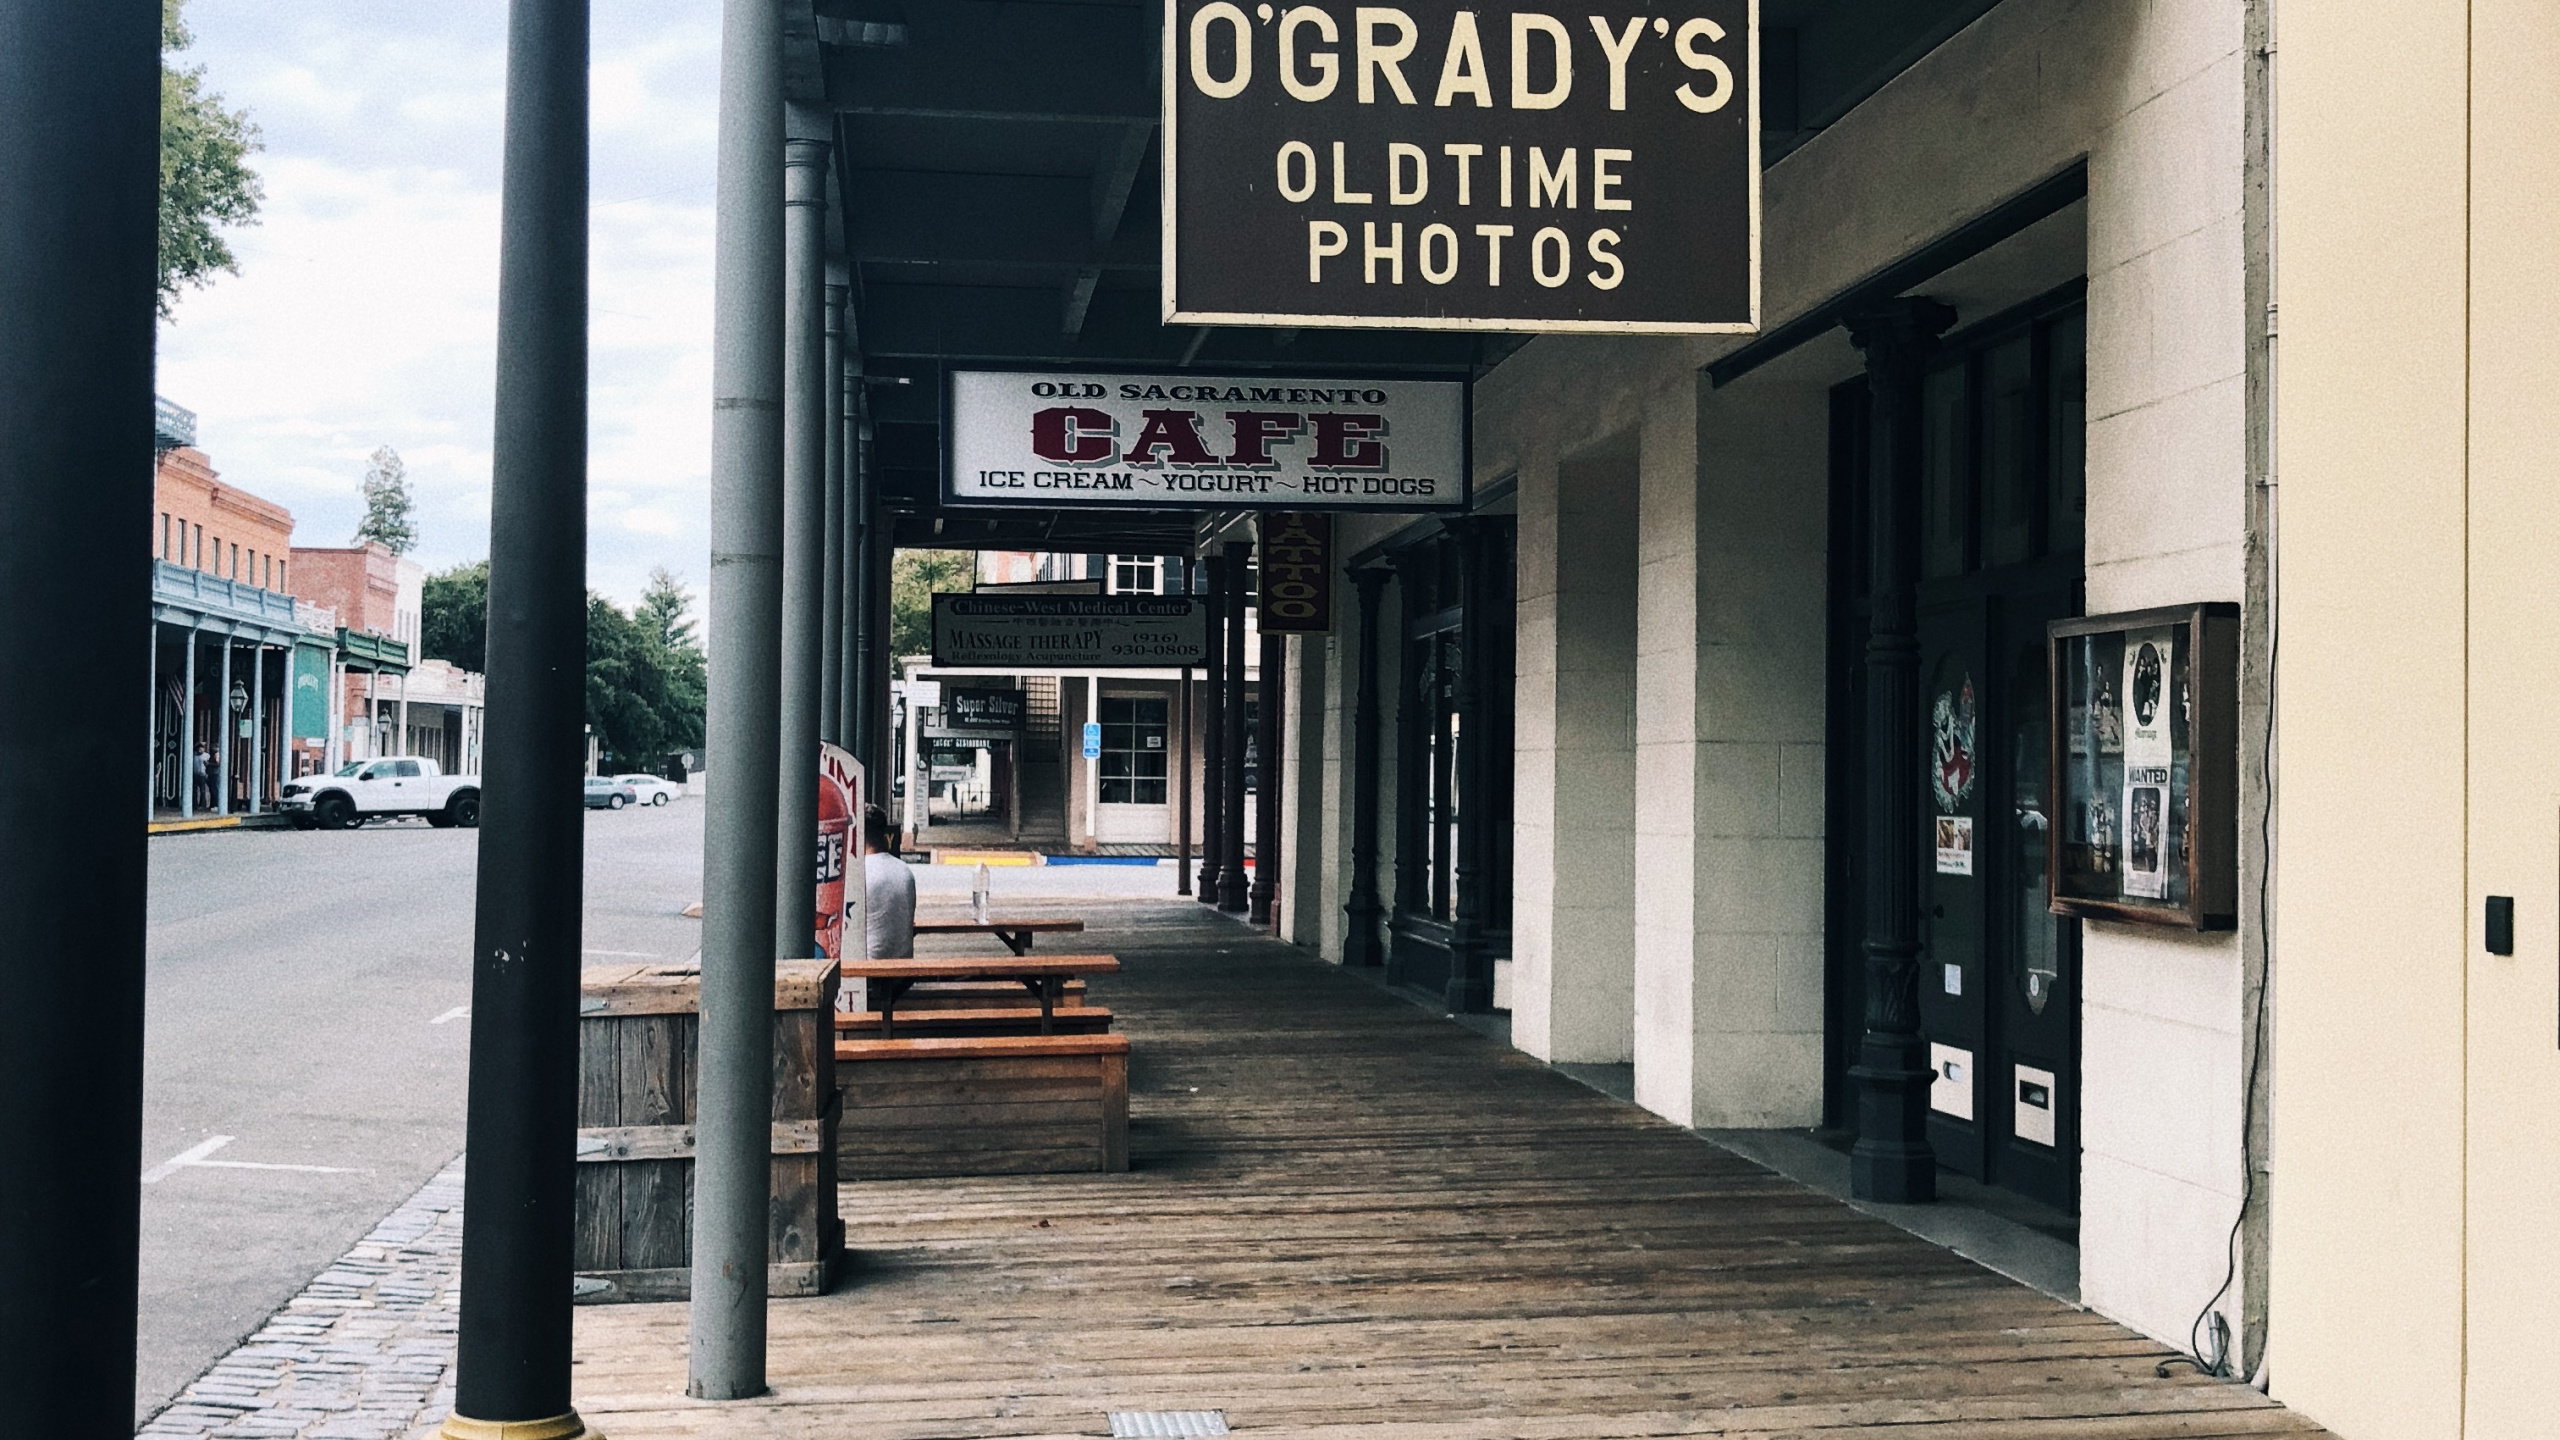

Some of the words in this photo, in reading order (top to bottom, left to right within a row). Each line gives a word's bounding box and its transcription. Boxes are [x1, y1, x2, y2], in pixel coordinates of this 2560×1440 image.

[1188, 1, 1734, 114] O'GRADY'S
[1275, 139, 1633, 211] OLDTIME
[1308, 219, 1625, 291] PHOTOS
[1030, 381, 1107, 400] OLD
[1118, 383, 1387, 405] SACRAMENTO
[1029, 405, 1390, 473] CAFE
[978, 470, 1025, 489] ICE
[1032, 471, 1135, 491] CREAM
[1161, 473, 1273, 494] YOGURT
[1301, 475, 1358, 495] HOT
[1362, 476, 1435, 496] DOGS
[955, 600, 1062, 615] Chinese-West
[1068, 600, 1129, 615] Medical
[1136, 601, 1188, 616] Center
[948, 629, 1022, 650] MASSAGE
[1028, 629, 1104, 650] THERAPY
[1111, 644, 1199, 656] 930-0808
[1132, 632, 1178, 644] (916)
[951, 651, 1022, 662] Reflexology
[1026, 651, 1102, 662] Acupuncture
[956, 694, 986, 718] Super
[989, 695, 1019, 716] Silver
[2128, 767, 2168, 784] WANTED
